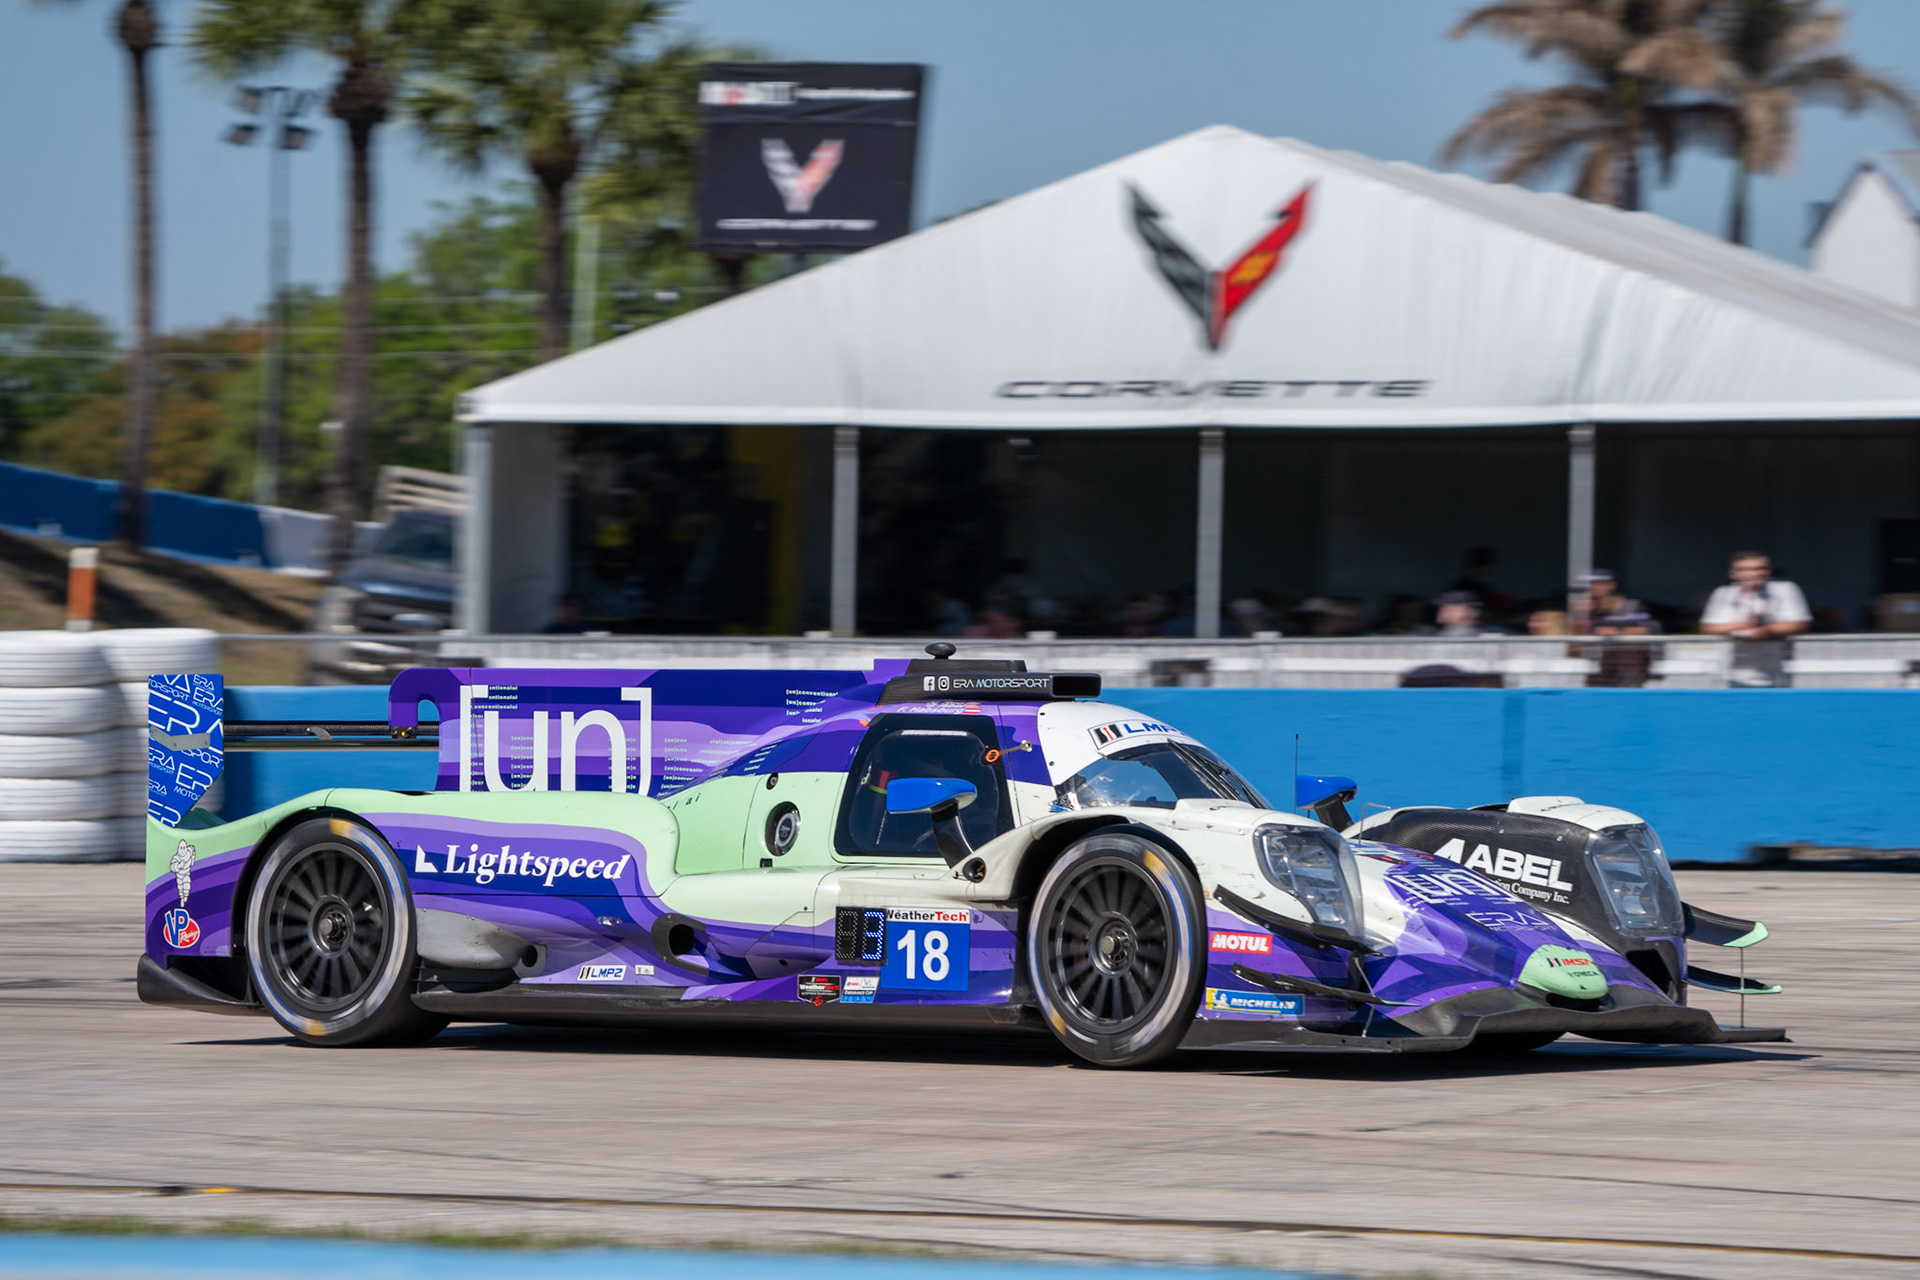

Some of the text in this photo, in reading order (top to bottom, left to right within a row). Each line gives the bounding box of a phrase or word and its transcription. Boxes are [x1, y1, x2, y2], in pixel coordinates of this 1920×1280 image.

[995, 380, 1430, 398] CORVETTE
[194, 674, 215, 691] ERA
[953, 678, 1050, 688] ERA MOTORSPORT
[909, 706, 965, 714] Habsburg
[1123, 722, 1185, 736] LMP
[173, 785, 200, 801] MOTO
[443, 843, 631, 887] Lightspeed
[1511, 882, 1552, 902] Company
[1553, 891, 1570, 904] Inc.
[886, 909, 969, 922] WeatherTech
[1465, 911, 1549, 926] ERA
[165, 909, 190, 946] VP
[1212, 934, 1269, 952] MOTUL
[897, 929, 950, 981] 18
[590, 968, 623, 978] LMP2
[1230, 997, 1296, 1010] MICHELIN
